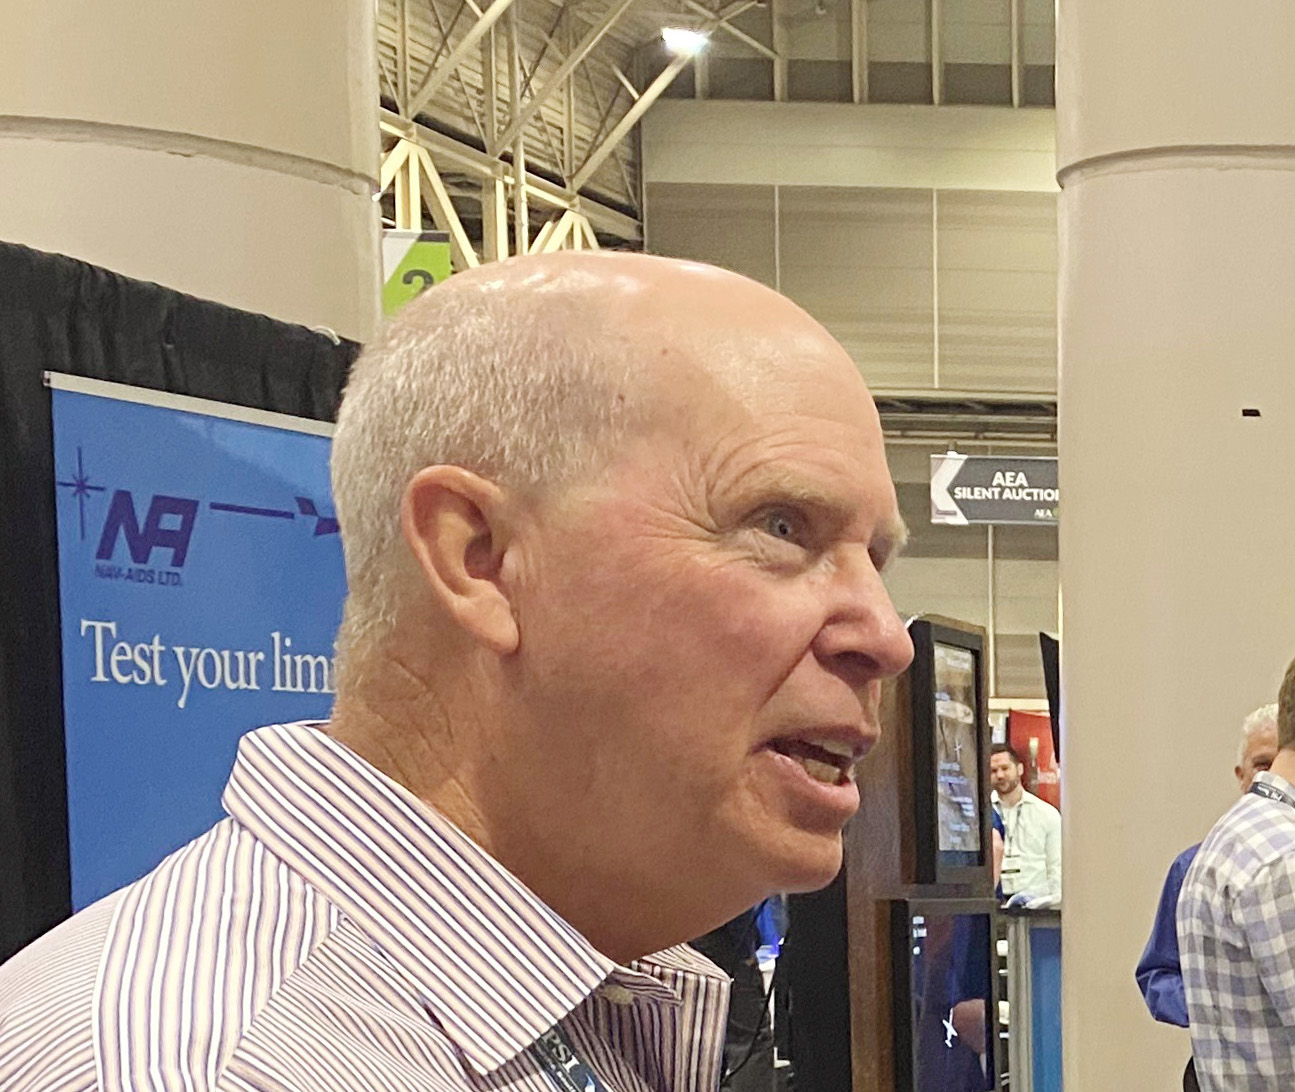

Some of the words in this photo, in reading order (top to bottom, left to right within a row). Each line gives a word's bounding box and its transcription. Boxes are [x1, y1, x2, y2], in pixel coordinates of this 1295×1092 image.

[954, 487, 1000, 500] SILENT
[992, 471, 1028, 487] AEA
[80, 618, 168, 686] Test
[173, 645, 265, 709] your
[541, 1030, 579, 1073] PSI
